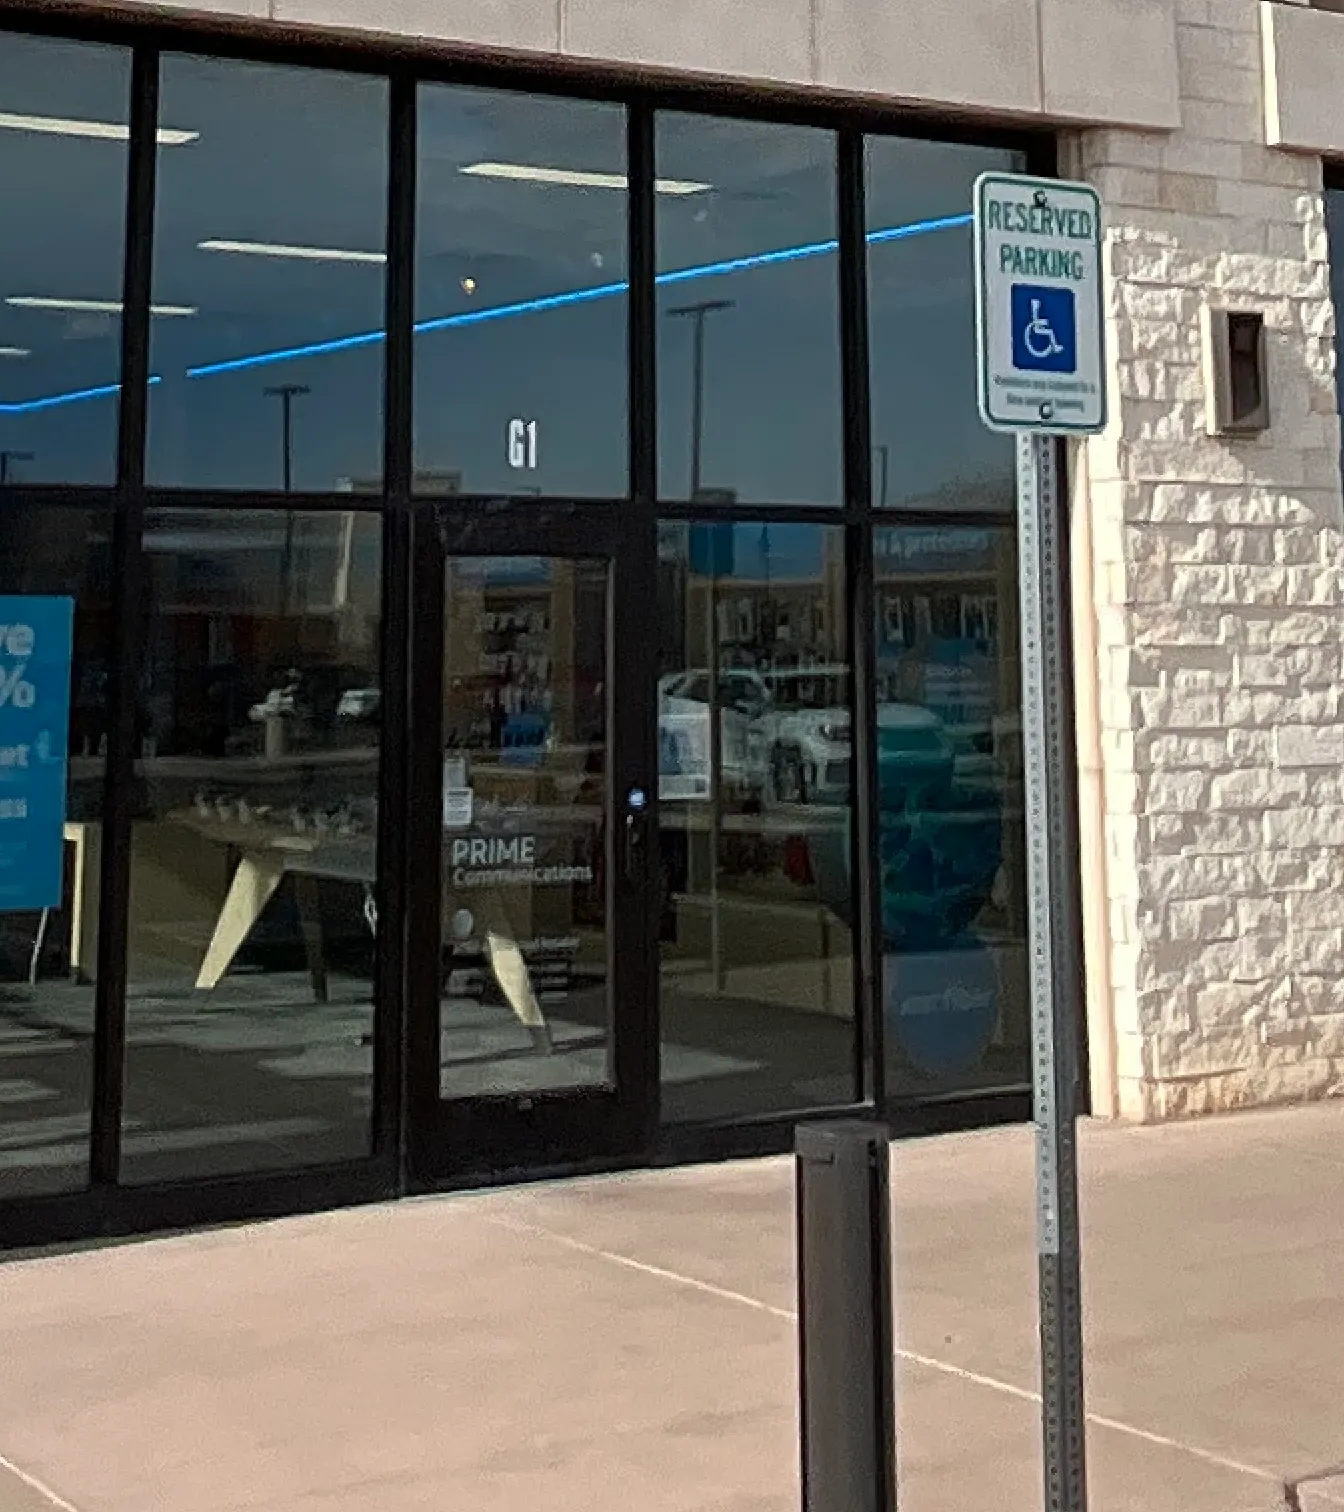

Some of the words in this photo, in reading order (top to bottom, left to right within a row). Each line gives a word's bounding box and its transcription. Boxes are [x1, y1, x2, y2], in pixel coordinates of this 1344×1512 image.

[988, 199, 1092, 239] RESERVED
[999, 243, 1085, 281] PARKING
[508, 418, 537, 468] G1
[452, 836, 536, 867] PRIME
